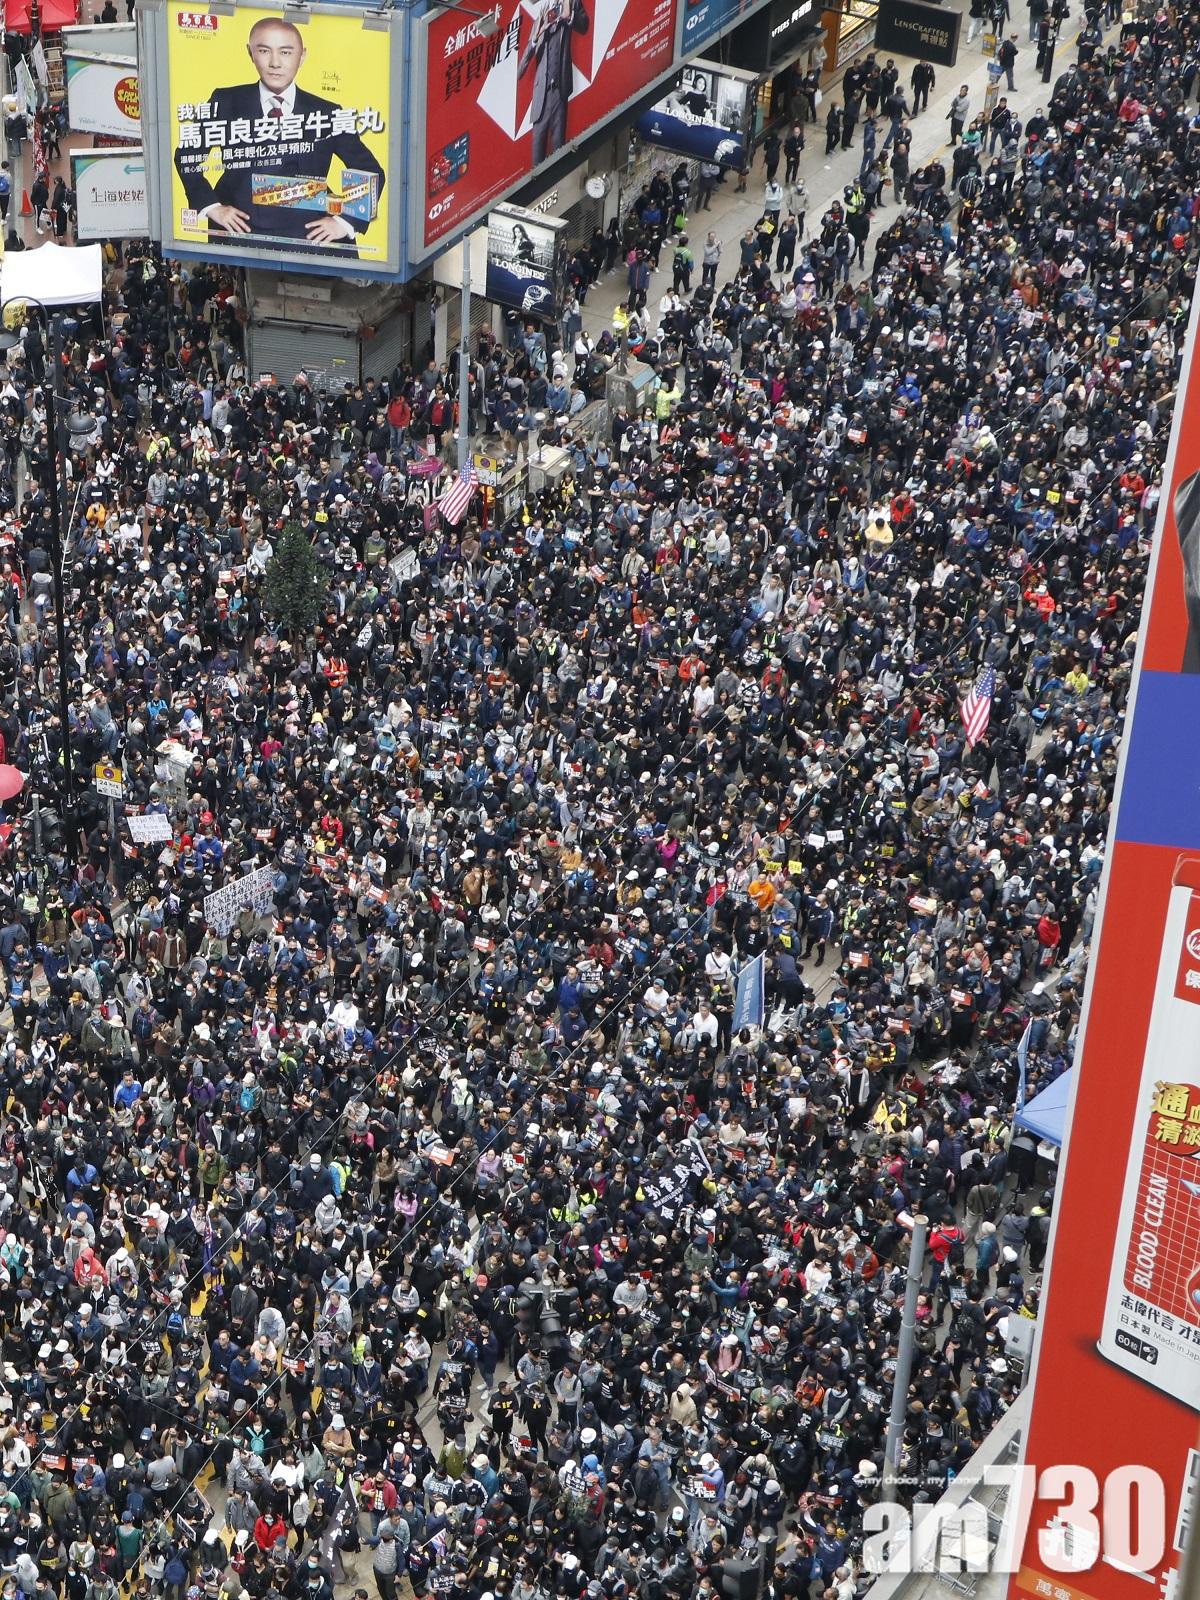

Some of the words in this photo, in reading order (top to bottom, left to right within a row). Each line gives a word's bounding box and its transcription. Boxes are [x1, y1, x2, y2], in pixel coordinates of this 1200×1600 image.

[178, 106, 384, 149] 馬百良安宮牛黃丸
[496, 257, 546, 280] LONGINES
[1143, 1173, 1169, 1227] CLEAN
[1133, 1231, 1159, 1289] BLOOD
[1120, 1313, 1151, 1336] 日本製
[1153, 1331, 1175, 1347] Made
[1121, 1295, 1175, 1331] 志偉代言
